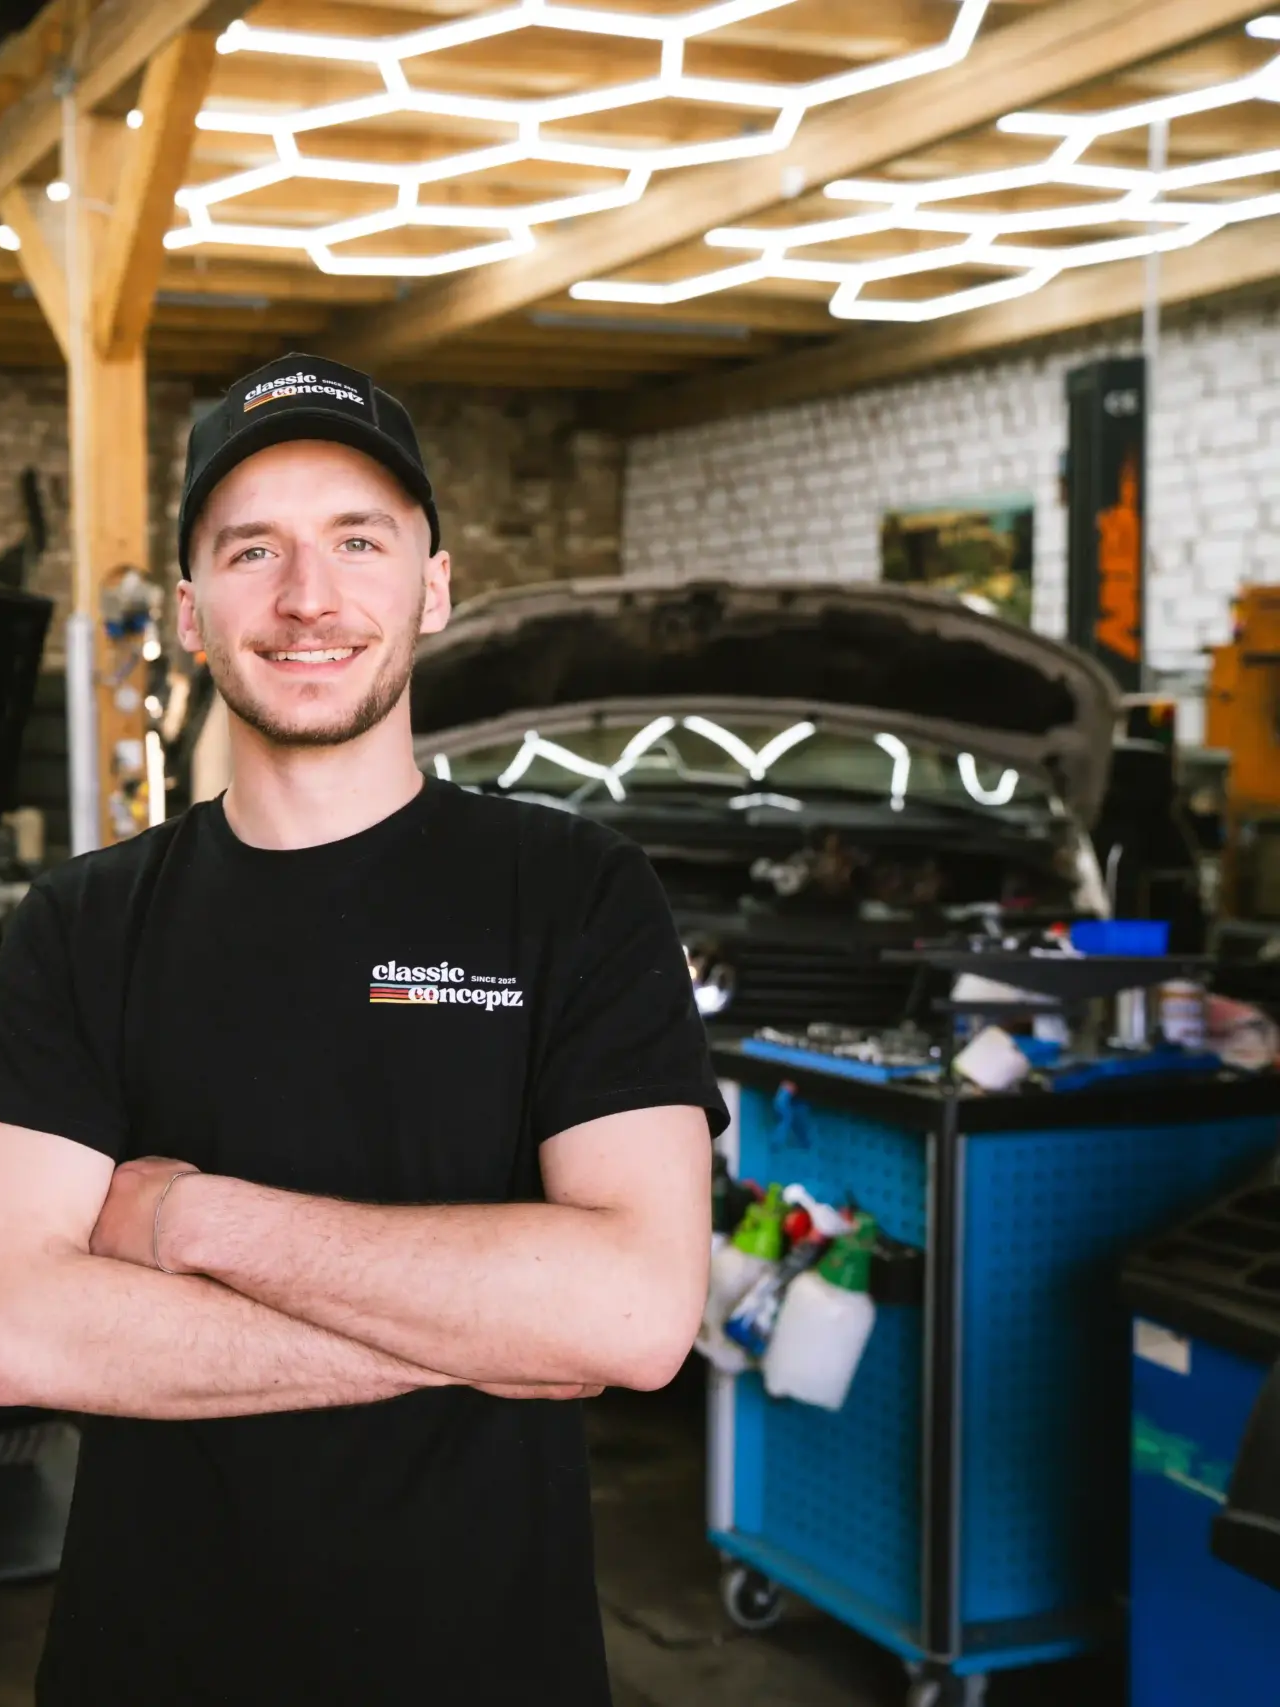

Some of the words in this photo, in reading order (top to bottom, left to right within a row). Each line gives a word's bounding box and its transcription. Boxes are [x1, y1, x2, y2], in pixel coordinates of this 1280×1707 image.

[244, 372, 317, 401] classic
[271, 384, 365, 406] conceptz
[372, 960, 465, 983] classic
[471, 975, 497, 984] SINCE
[498, 977, 517, 985] 2025
[407, 987, 523, 1011] conceptz
